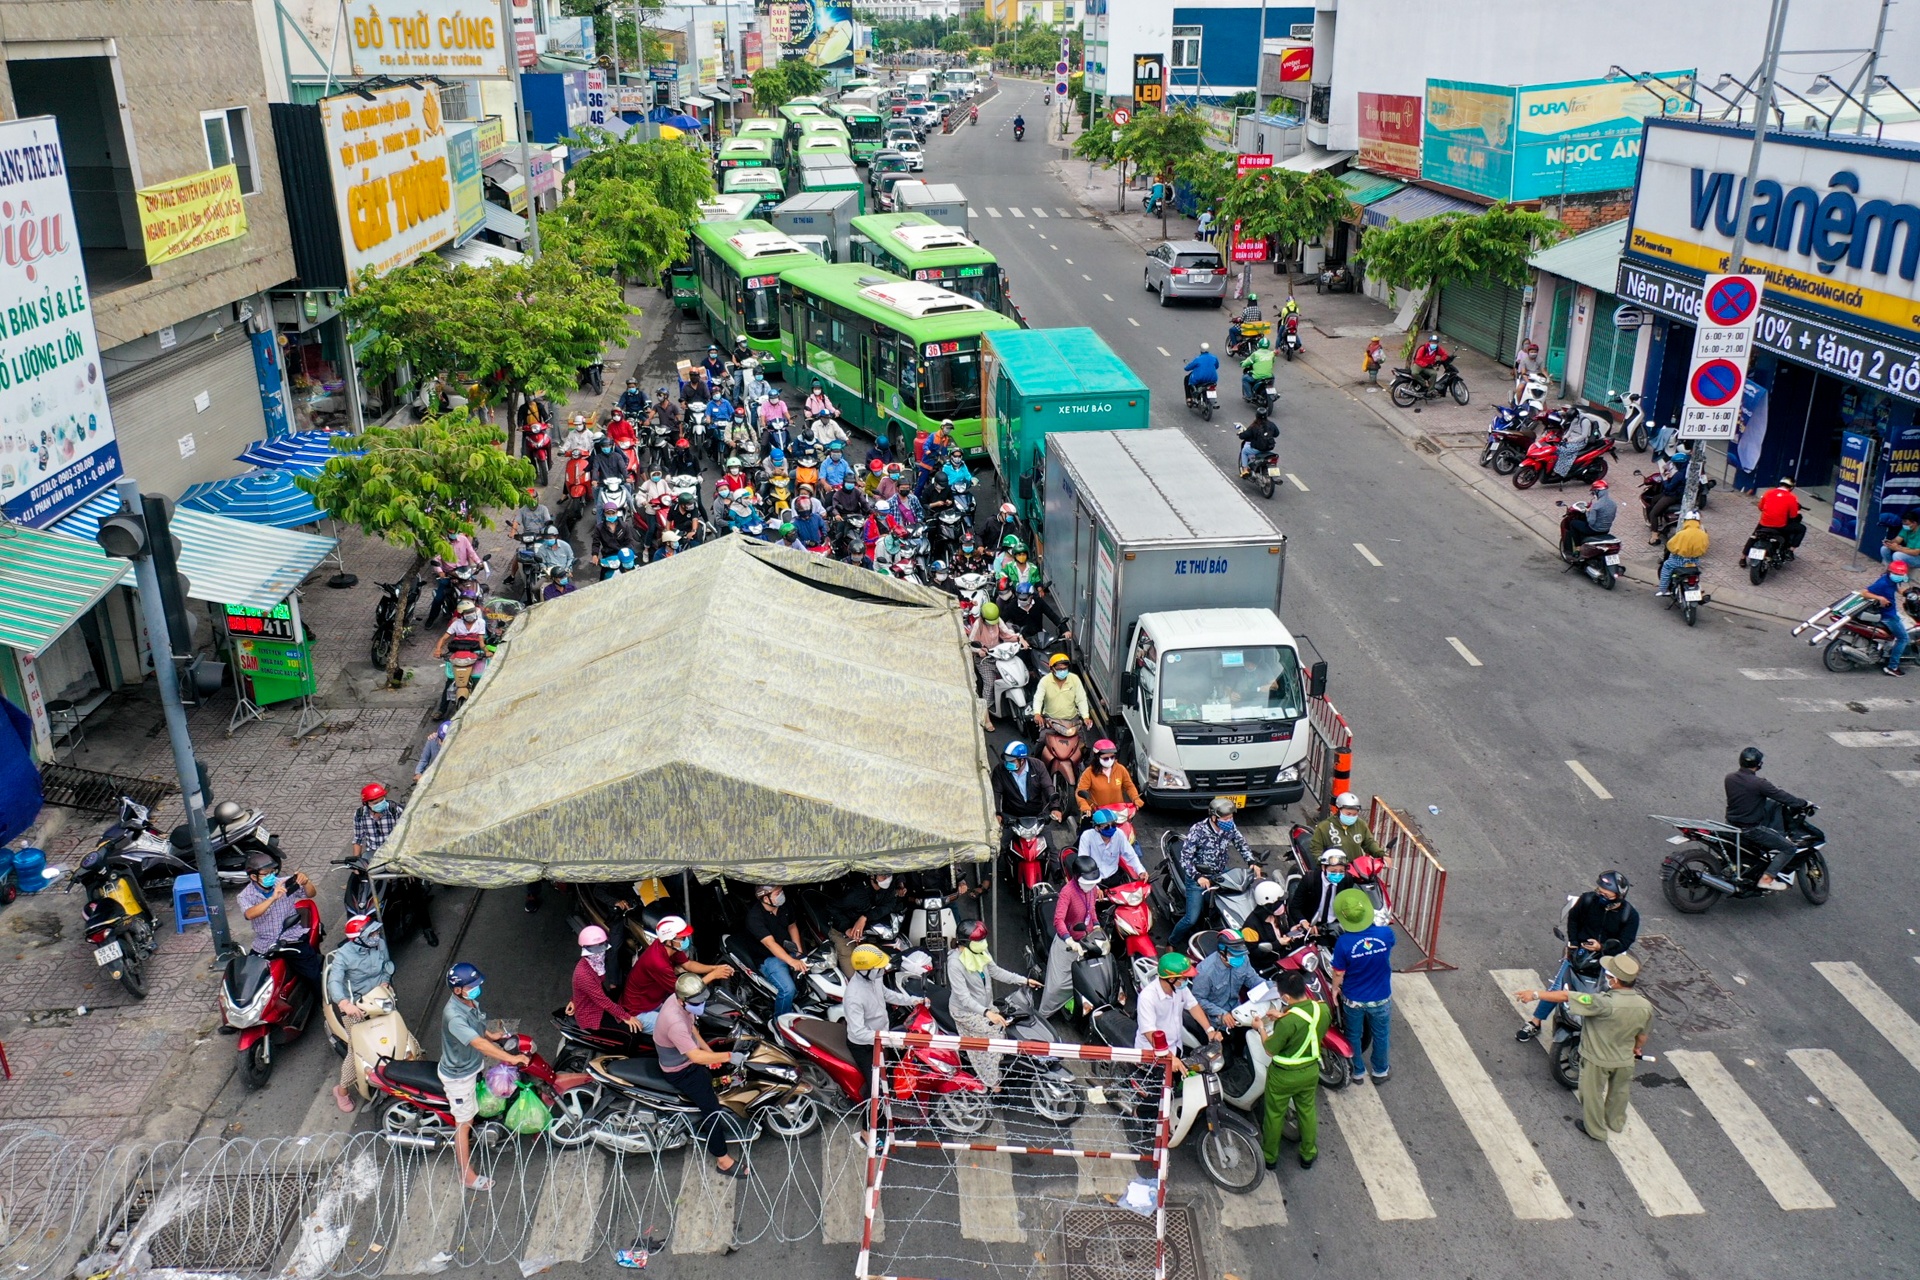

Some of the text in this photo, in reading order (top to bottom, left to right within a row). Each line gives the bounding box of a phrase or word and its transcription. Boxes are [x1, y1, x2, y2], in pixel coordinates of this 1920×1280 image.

[353, 4, 495, 49] ĐỒ THỜ CÚNG
[588, 82, 602, 90] SIM
[1135, 85, 1162, 102] LED
[588, 93, 603, 108] 3G
[590, 110, 604, 125] 4G
[23, 130, 46, 181] TRẺ
[44, 143, 63, 176] EM
[1546, 143, 1603, 167] NGỌC
[0, 200, 69, 281] iệu
[8, 297, 39, 336] BÁN
[40, 285, 55, 324] SỈ
[57, 291, 68, 318] &
[68, 275, 85, 313] LẺ
[1627, 271, 1659, 303] Nệm
[1663, 282, 1704, 317] Pride
[1756, 313, 1792, 349] 10%
[1817, 333, 1864, 379] tặng
[1868, 350, 1885, 380] 2
[11, 343, 58, 385] LƯỢNG
[57, 327, 84, 364] LỚN
[928, 345, 939, 356] 36
[1058, 402, 1112, 414] XE THƯ BÁO
[1891, 449, 1920, 461] MUA
[1889, 461, 1919, 475] TẶNG
[1175, 555, 1228, 575] XE THƯ BÁO
[263, 618, 292, 637] 411
[1217, 735, 1254, 745] ISUZU
